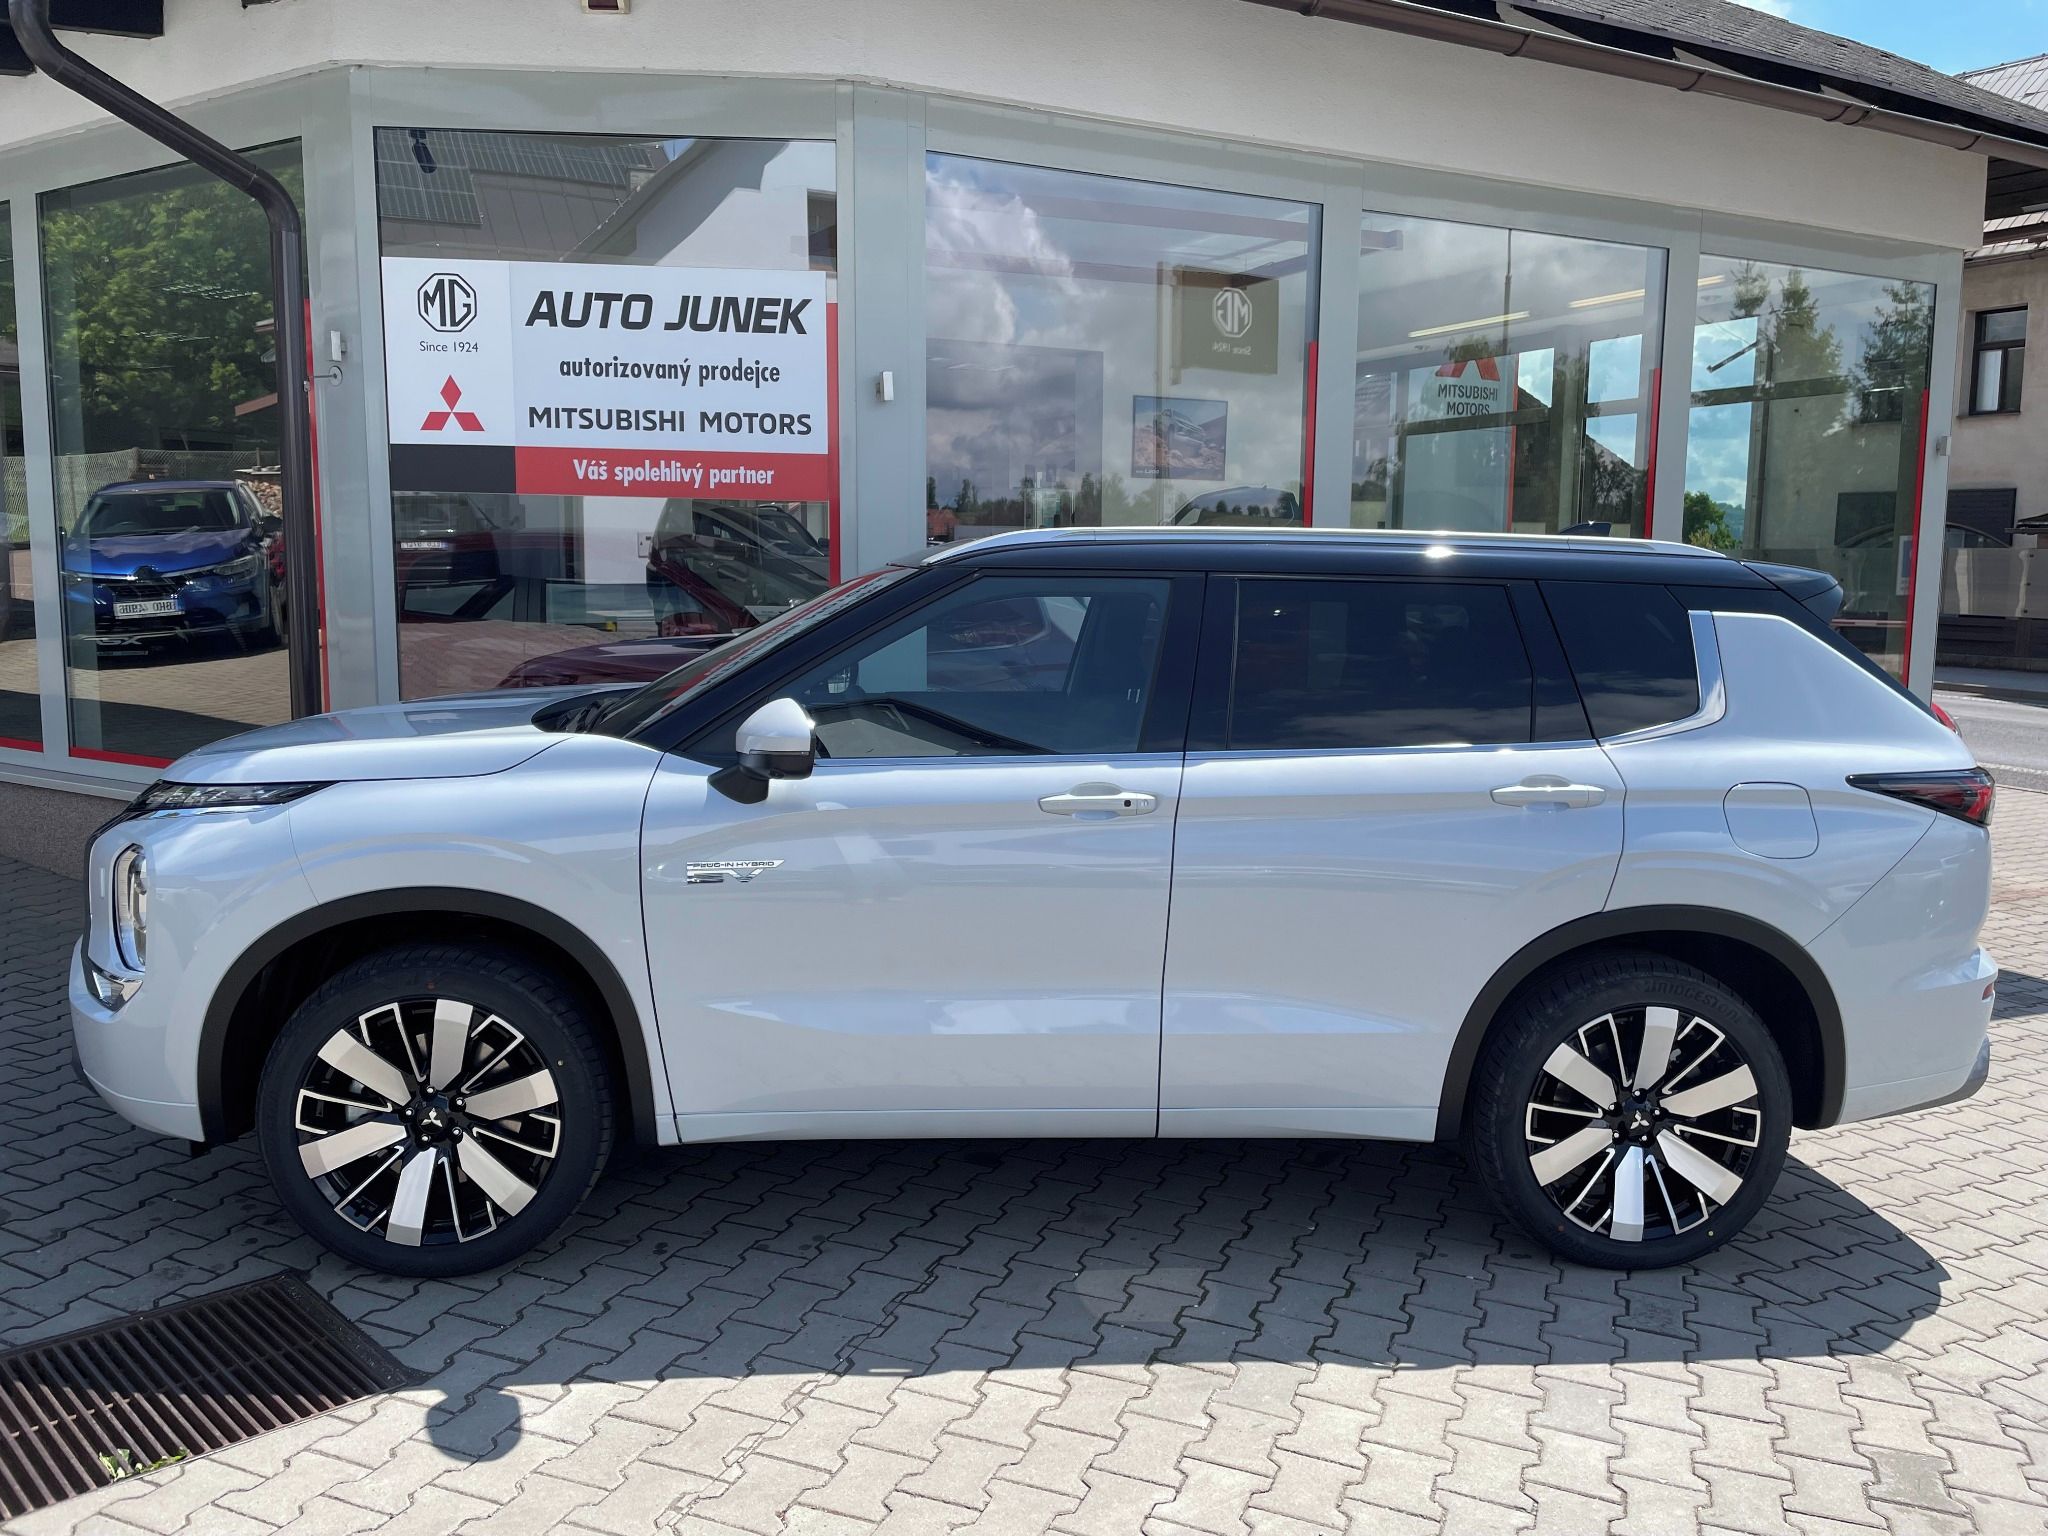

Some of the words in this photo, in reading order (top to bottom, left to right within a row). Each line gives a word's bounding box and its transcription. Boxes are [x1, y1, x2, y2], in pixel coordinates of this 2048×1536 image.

[420, 276, 475, 330] MG
[525, 290, 653, 330] AUTO
[664, 295, 813, 335] JUNEK
[419, 340, 448, 352] Since
[453, 341, 479, 353] 1924
[559, 355, 691, 386] autorizovaný
[698, 357, 781, 388] prodejce
[1438, 383, 1498, 401] MITSUBISHI
[528, 406, 685, 432] MITSUBISHI
[699, 411, 812, 436] MOTORS
[1447, 401, 1490, 416] MOTORS
[573, 459, 608, 481] Váš
[614, 460, 703, 488] spolehlivý
[709, 465, 775, 489] partner
